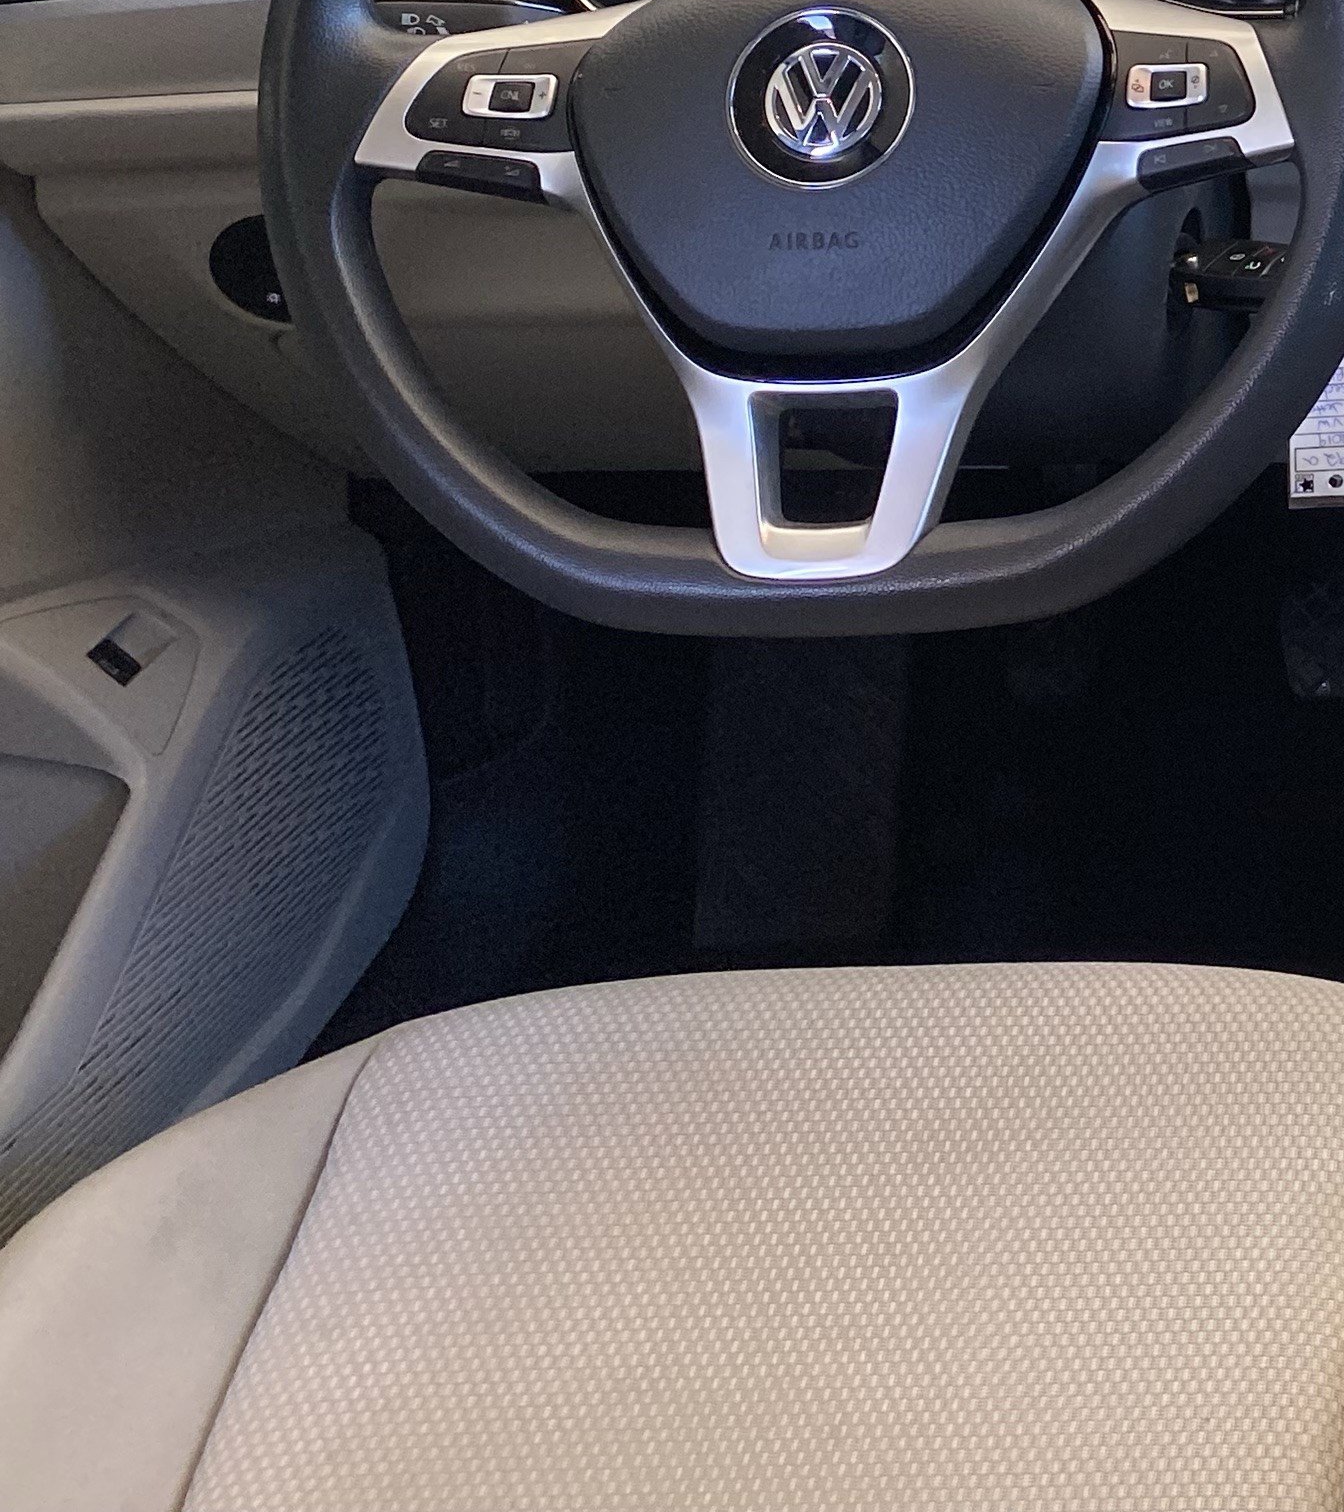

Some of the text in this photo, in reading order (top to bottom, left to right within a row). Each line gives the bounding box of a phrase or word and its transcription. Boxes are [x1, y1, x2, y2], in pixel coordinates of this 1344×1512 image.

[1158, 79, 1175, 90] OK
[429, 117, 448, 129] SET
[769, 231, 860, 253] AIRBAG
